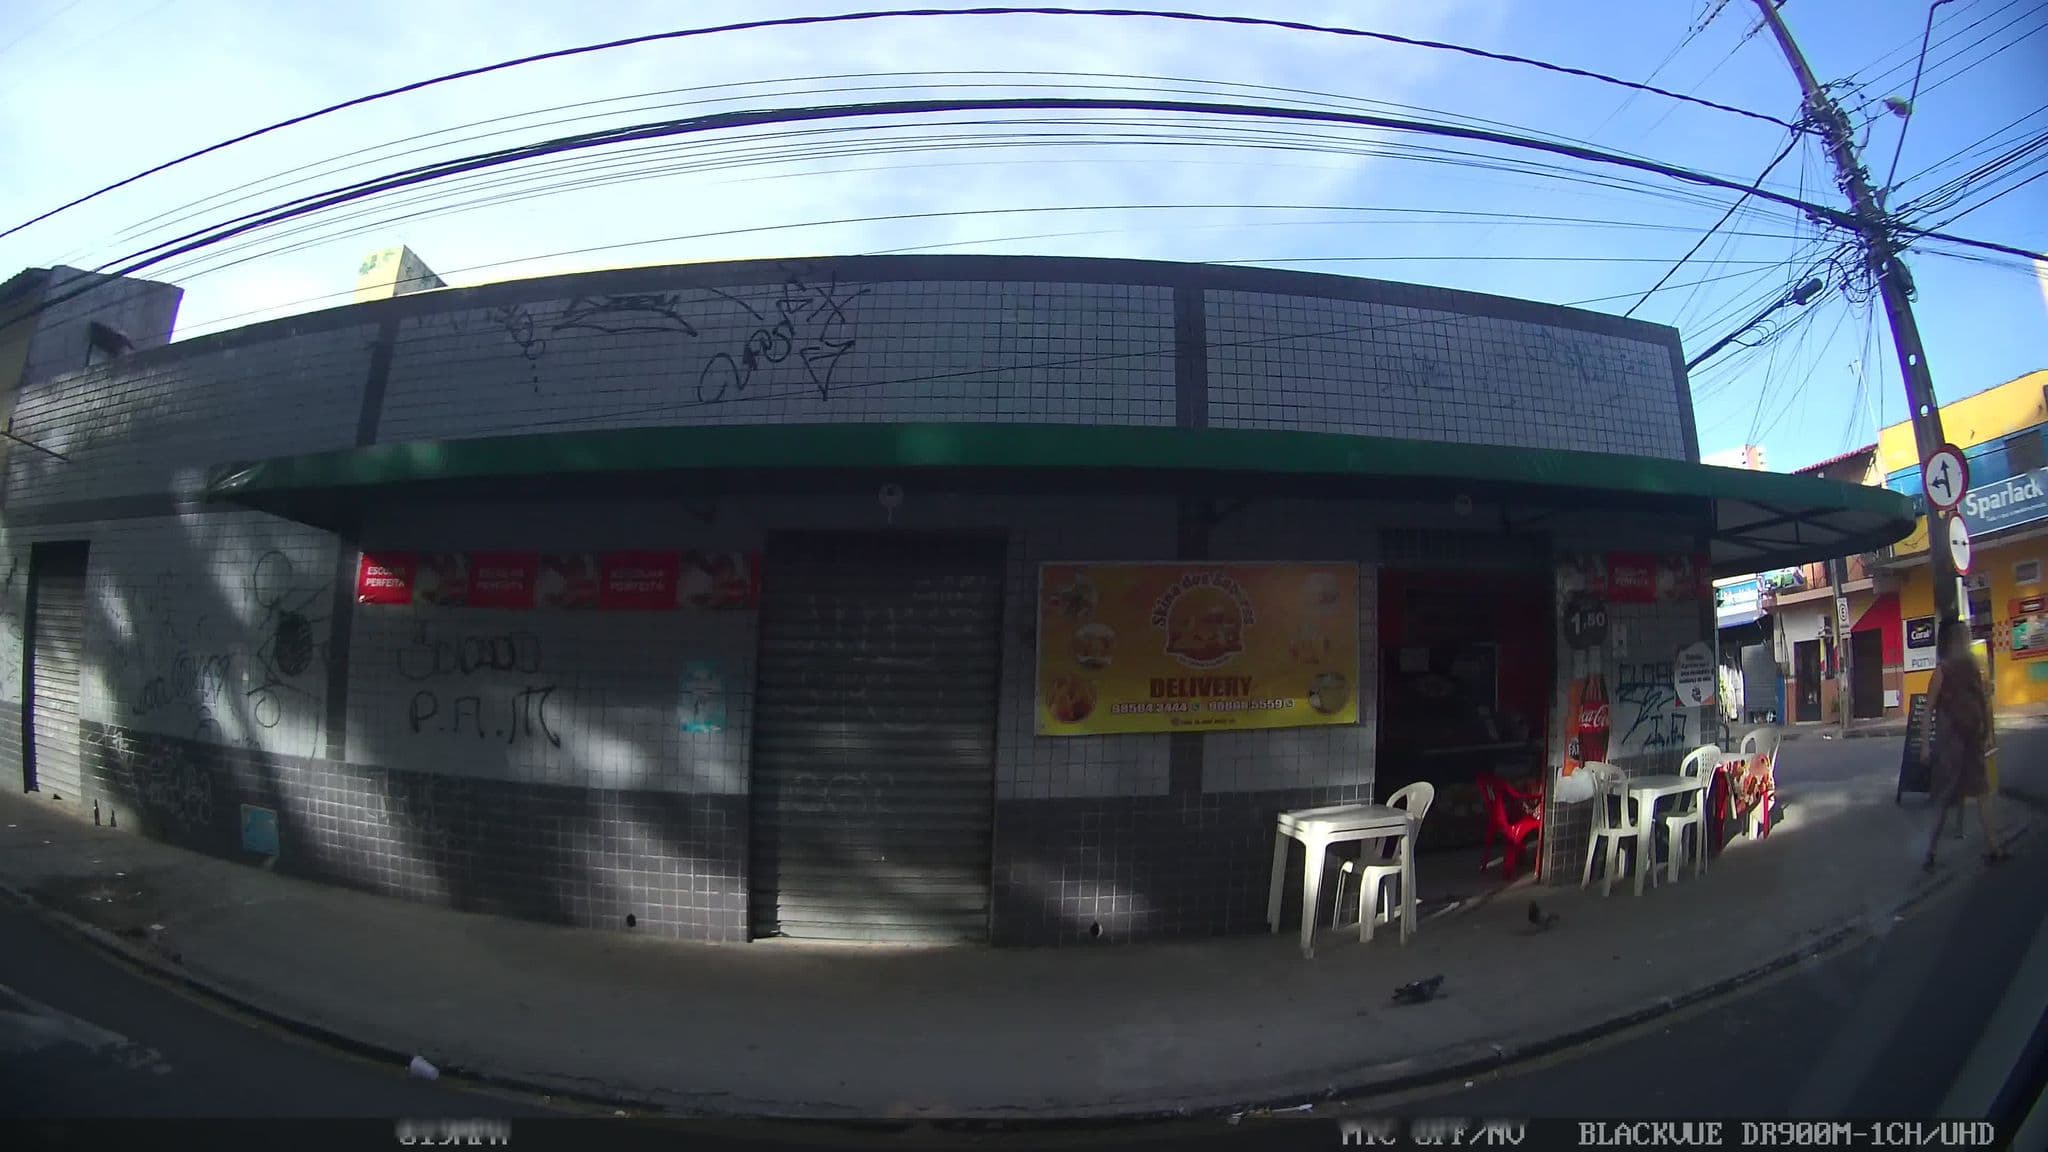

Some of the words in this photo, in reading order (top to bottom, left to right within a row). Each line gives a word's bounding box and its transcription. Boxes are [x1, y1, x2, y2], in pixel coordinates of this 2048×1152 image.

[1966, 477, 2045, 519] Sparlack
[367, 566, 406, 576] ESCOL
[365, 577, 406, 588] PERFEITA
[1150, 675, 1253, 697] DELIVERY
